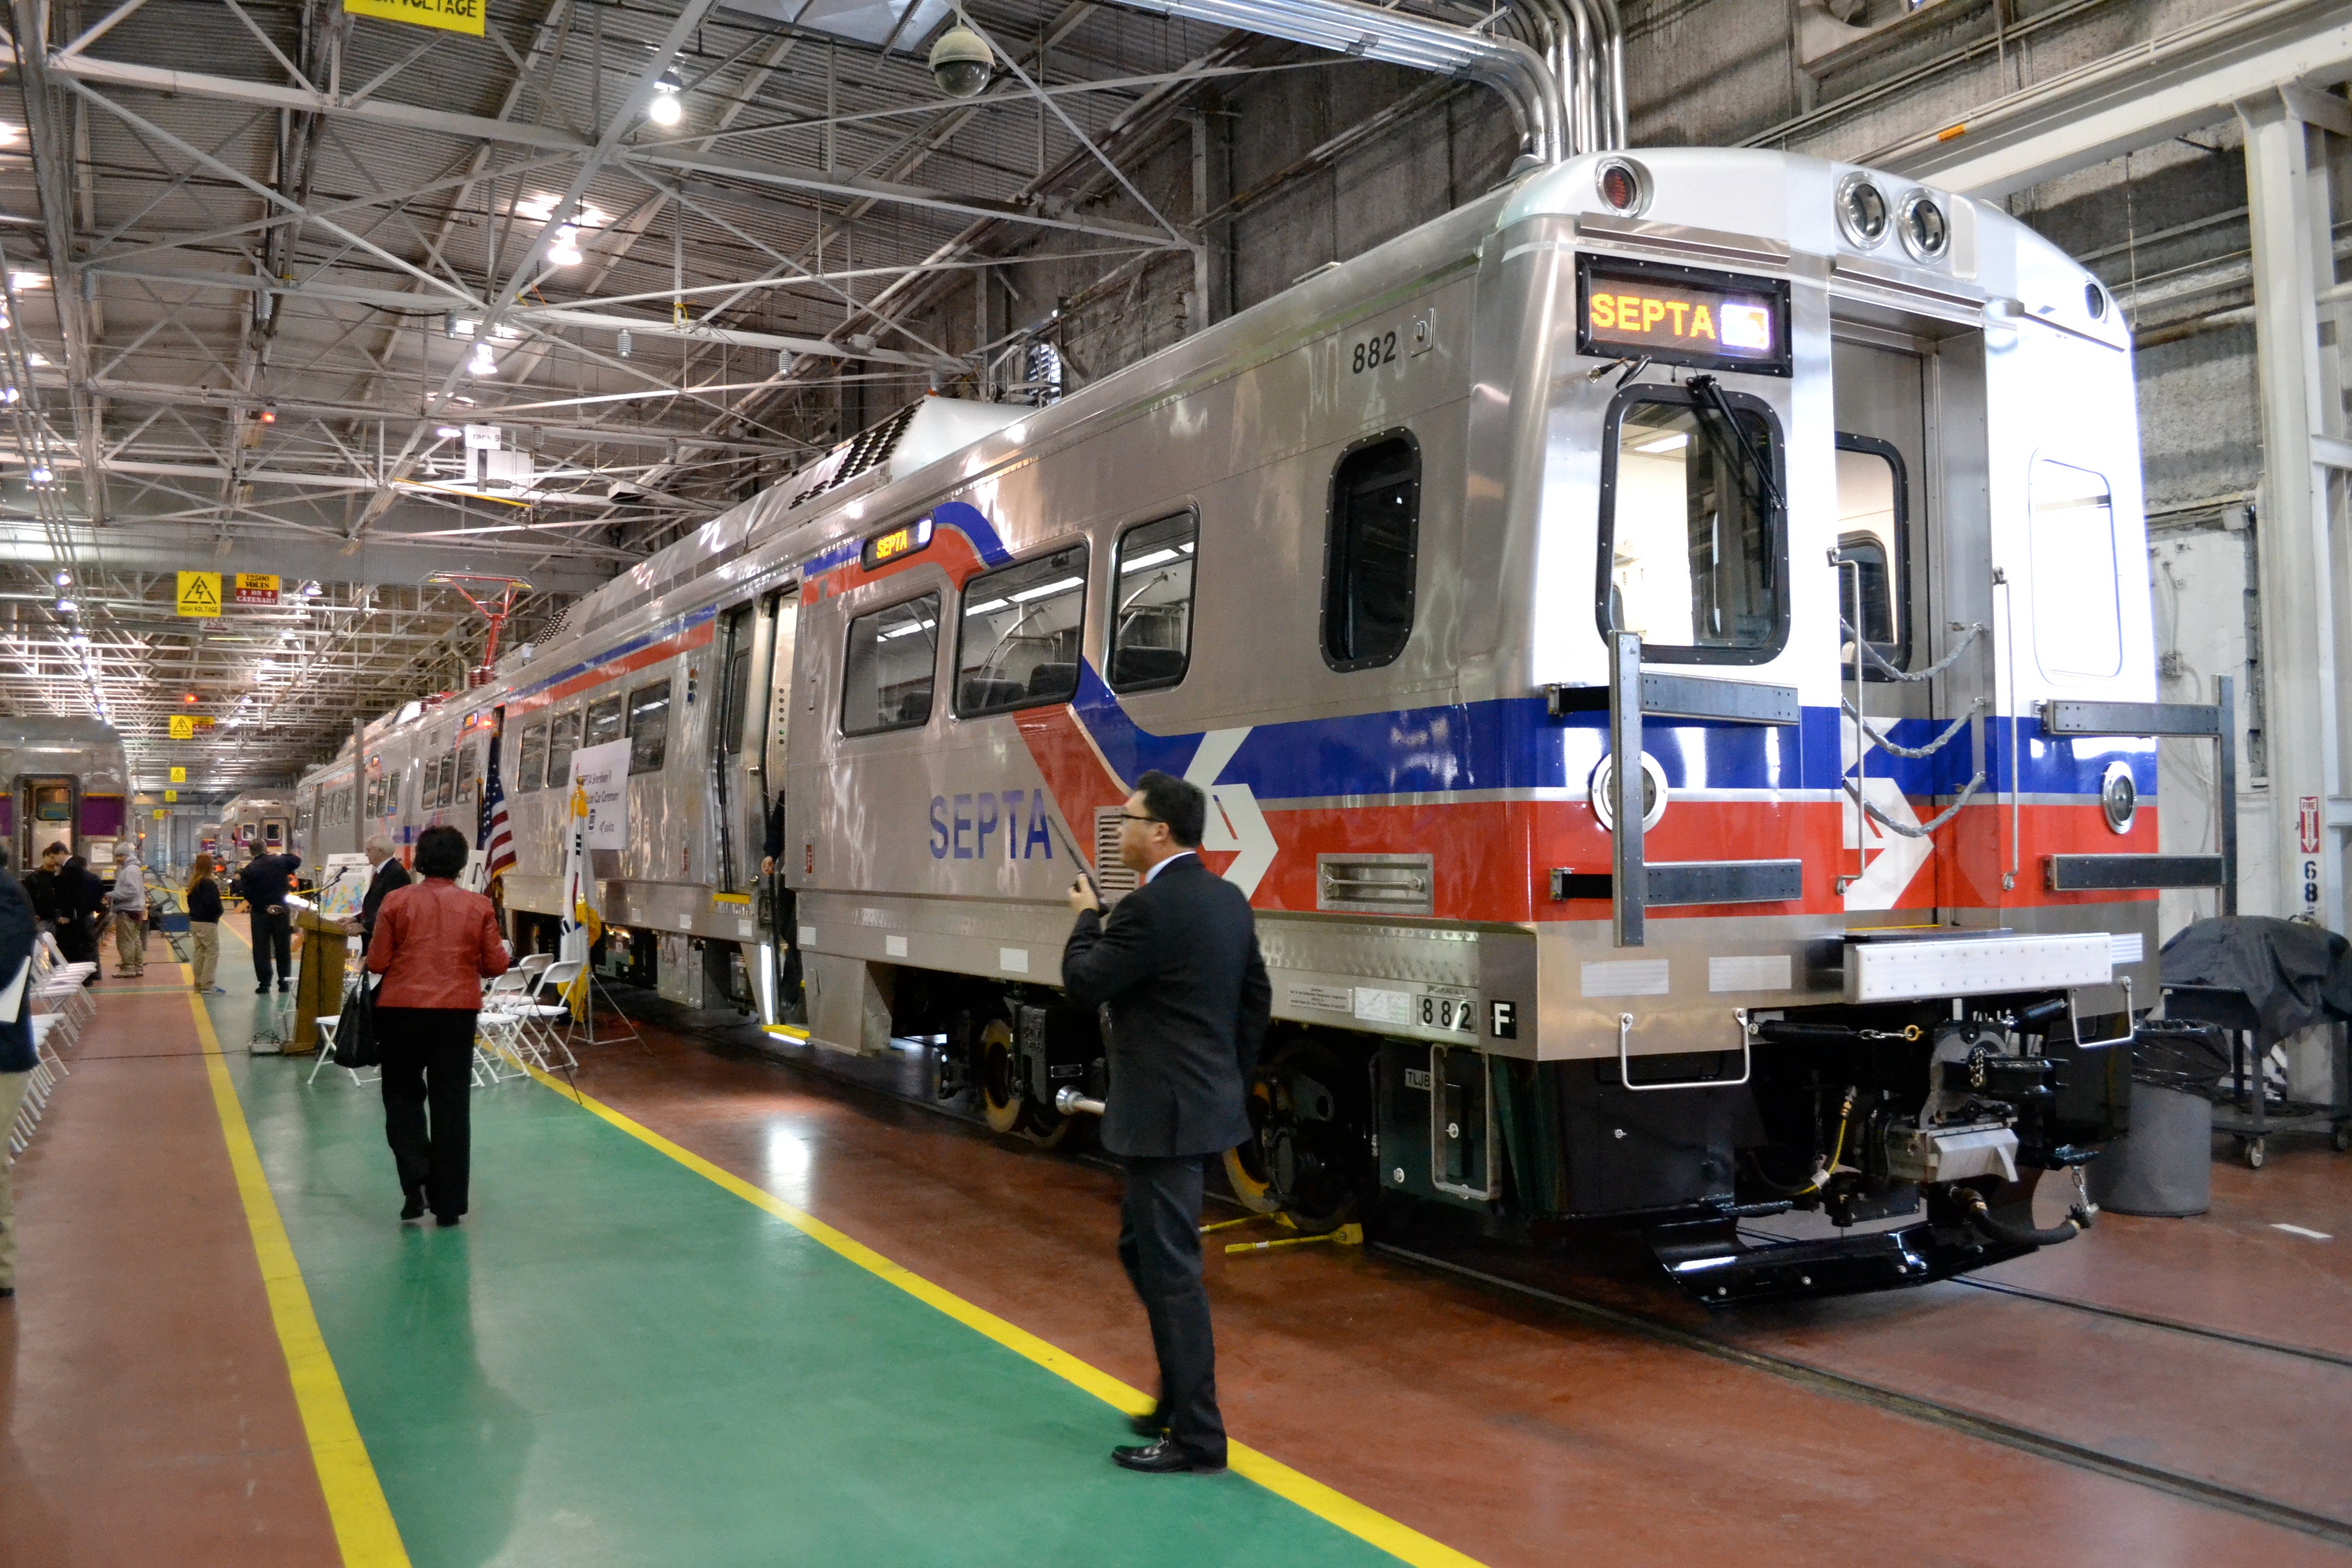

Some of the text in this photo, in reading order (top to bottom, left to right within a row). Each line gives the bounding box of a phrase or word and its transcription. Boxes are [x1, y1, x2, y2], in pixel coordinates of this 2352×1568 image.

[1590, 293, 1716, 339] SEPTA
[1353, 331, 1396, 374] 882
[876, 529, 907, 559] SEPTA
[236, 596, 276, 604] CATENARY
[930, 789, 1052, 859] SEPTA
[1494, 1003, 1510, 1035] F
